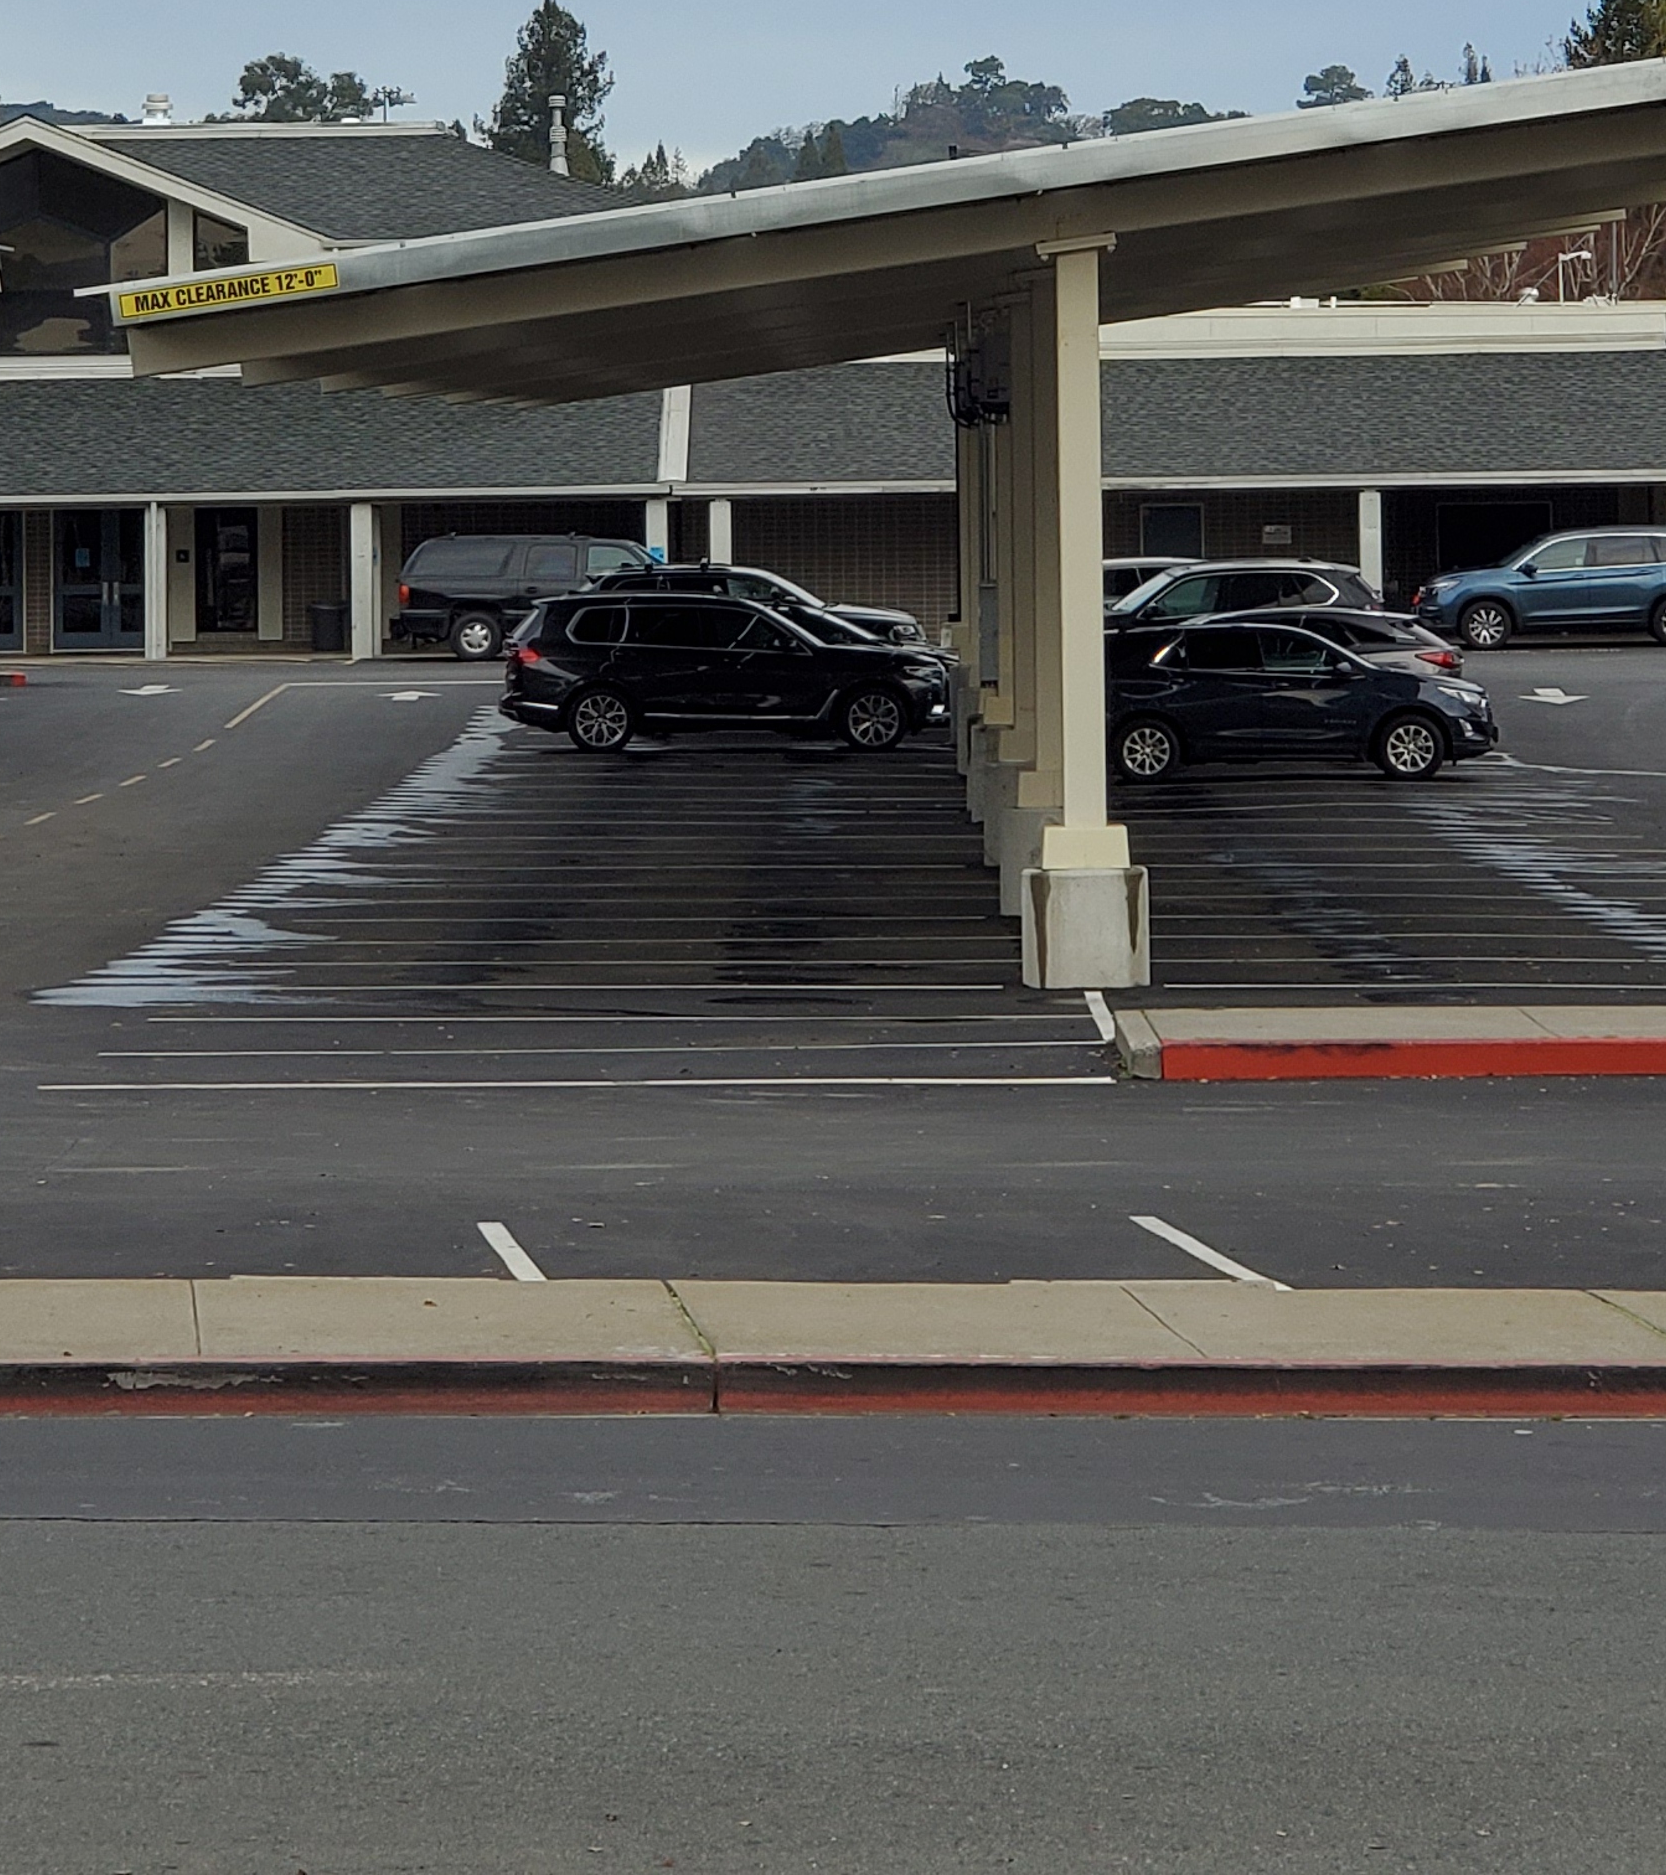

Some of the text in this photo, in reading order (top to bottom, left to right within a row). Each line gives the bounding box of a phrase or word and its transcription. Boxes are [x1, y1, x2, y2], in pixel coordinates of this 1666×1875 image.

[134, 270, 323, 312] MAX CLEARANCE 12'-0"
